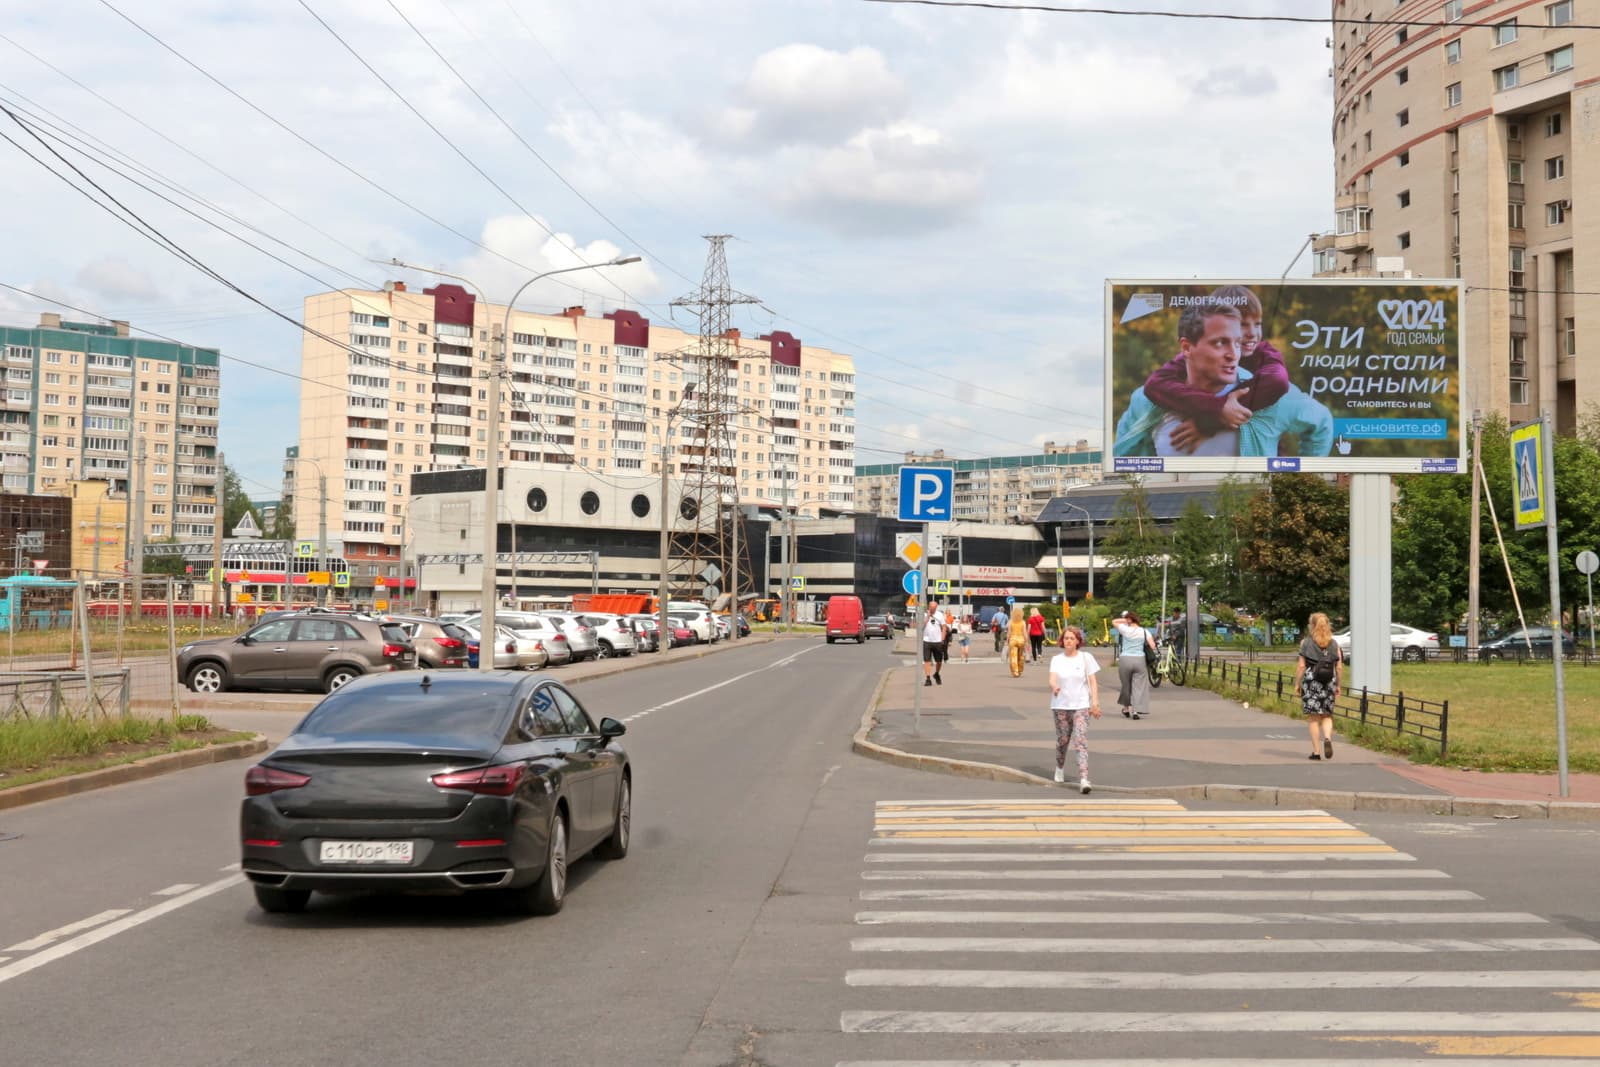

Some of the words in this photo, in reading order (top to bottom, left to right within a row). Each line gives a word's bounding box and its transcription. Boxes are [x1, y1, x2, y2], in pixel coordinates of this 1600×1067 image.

[1169, 296, 1248, 307] ДЕМОГРАФИЯ
[1379, 300, 1446, 330] 2024
[1292, 319, 1365, 349] Эти
[1300, 355, 1360, 369] люди
[1365, 355, 1446, 371] стали
[1309, 376, 1449, 399] родными
[1417, 401, 1432, 409] ВЫ
[1345, 422, 1442, 435] усыновите.рф
[913, 473, 943, 515] P
